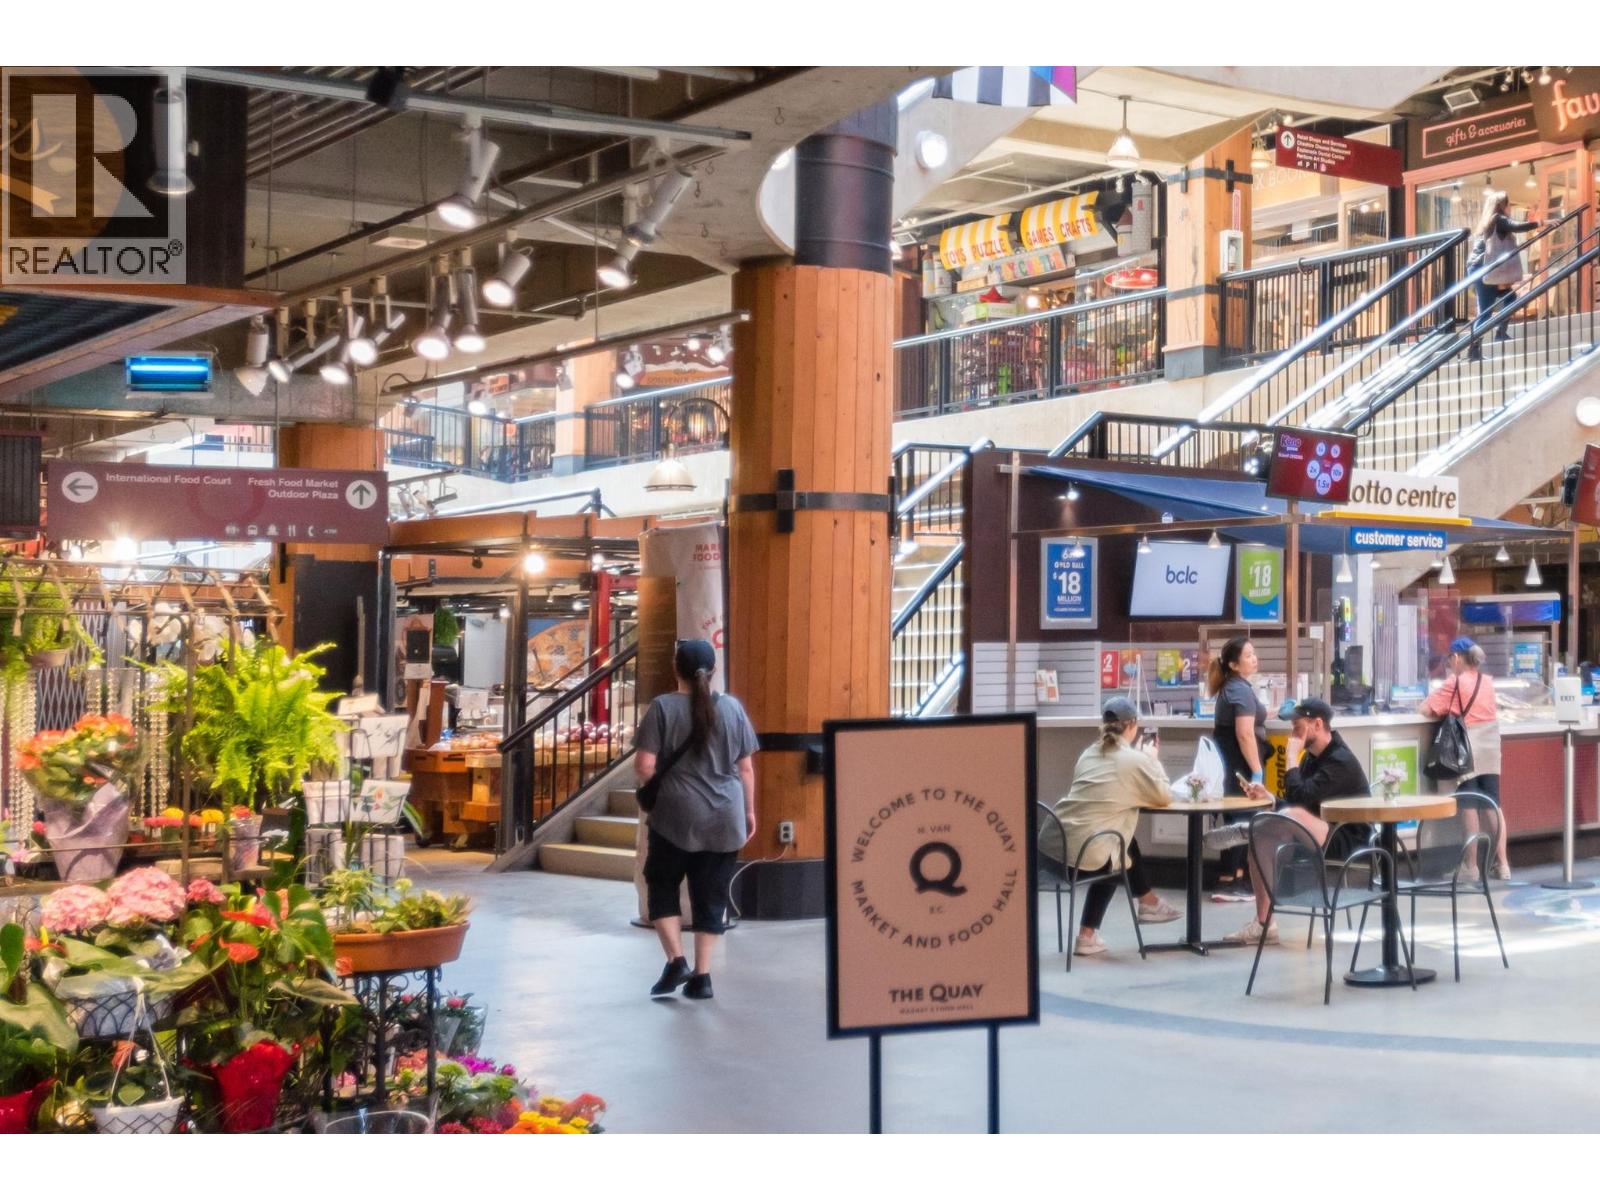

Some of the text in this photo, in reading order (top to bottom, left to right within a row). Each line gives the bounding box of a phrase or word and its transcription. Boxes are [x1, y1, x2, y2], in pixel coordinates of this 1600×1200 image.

[1446, 117, 1527, 147] gifts & accessories
[1025, 218, 1094, 247] GAMES CRAFTS
[944, 246, 967, 265] TOYS
[972, 238, 1009, 258] PUZZLE
[105, 471, 232, 486] International Food Court
[247, 477, 339, 489] Fresh Food Market
[267, 488, 339, 500] Outdoor Plaza
[1349, 480, 1457, 509] otto centre
[1354, 530, 1444, 549] customer service
[1052, 571, 1081, 595] $18
[1165, 564, 1199, 585] bclc
[851, 788, 1018, 863] WELCOME TO THE QUAY
[930, 824, 951, 833] VAN
[908, 840, 969, 897] Q
[851, 868, 1018, 949] MARKET AND FOOD HALL
[889, 983, 983, 1004] THE QUAY
